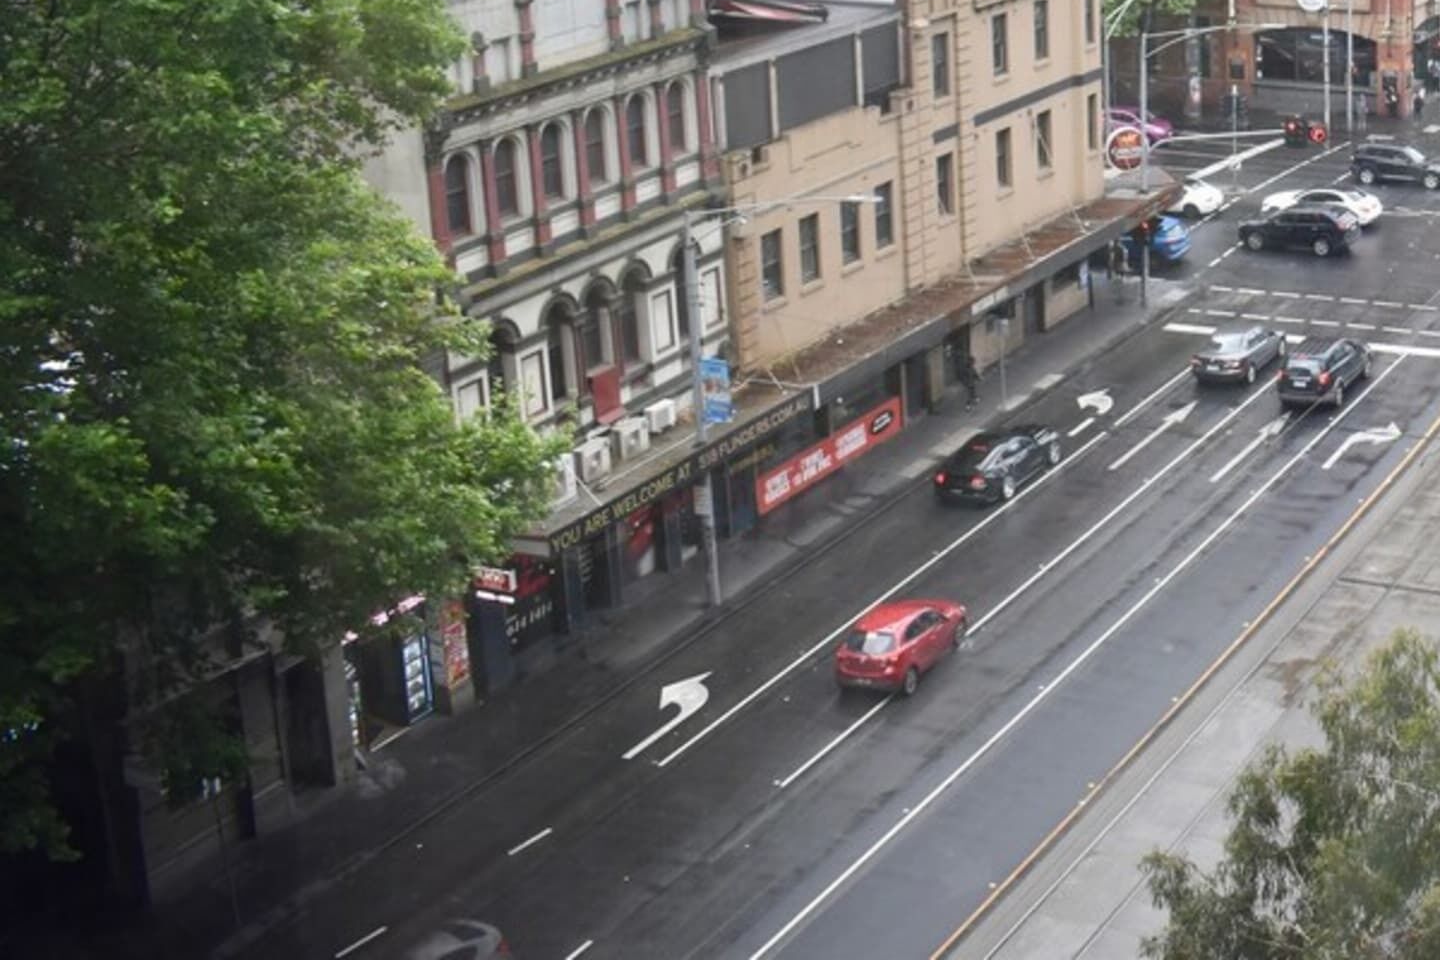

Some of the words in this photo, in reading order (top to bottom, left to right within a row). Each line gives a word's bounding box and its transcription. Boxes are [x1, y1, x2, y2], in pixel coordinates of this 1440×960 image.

[552, 523, 584, 553] YOU
[584, 507, 610, 536] ARE
[612, 474, 676, 521] WELCOME
[675, 462, 692, 487] AT
